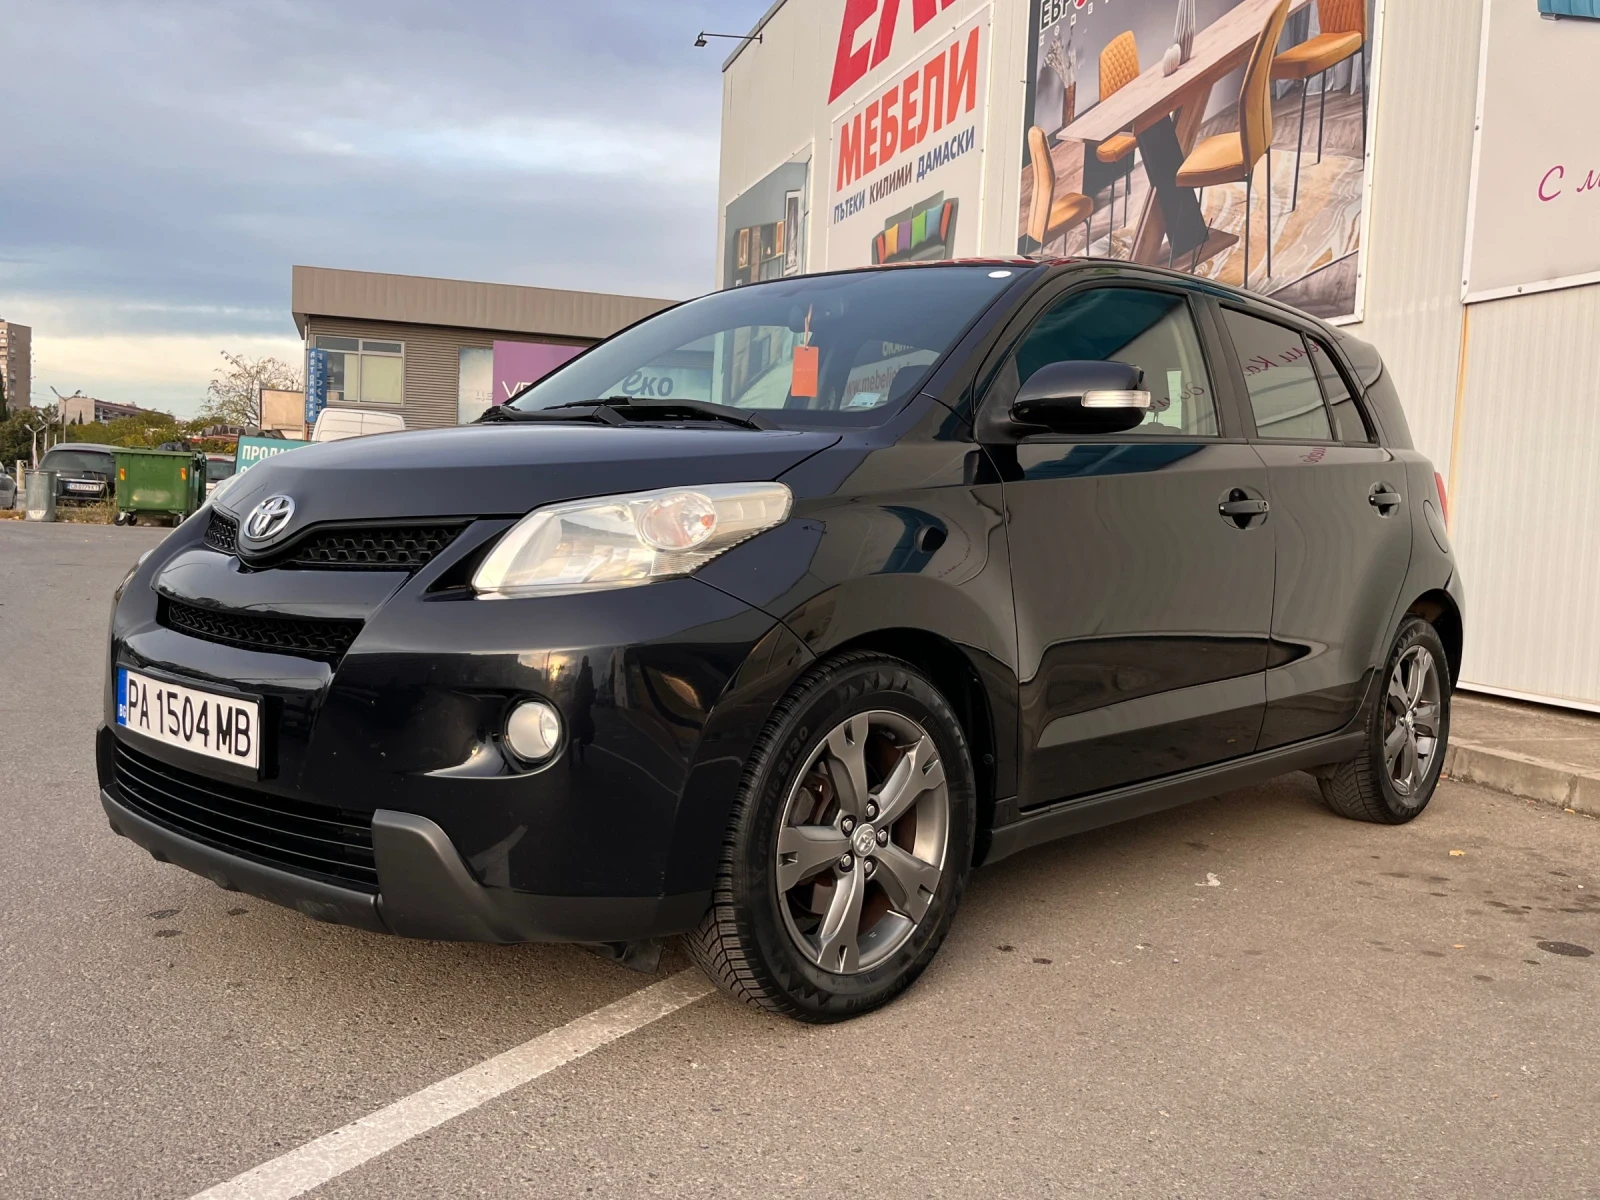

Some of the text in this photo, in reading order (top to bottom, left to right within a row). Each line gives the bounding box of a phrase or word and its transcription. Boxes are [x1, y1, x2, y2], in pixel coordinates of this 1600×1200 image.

[836, 25, 980, 193] МЕБЕЛИ
[833, 125, 976, 225] ПЪТЕКИ КИЛИМИ ДАМАСКИ
[119, 703, 127, 718] BG
[128, 678, 252, 757] PA 1504 MB
